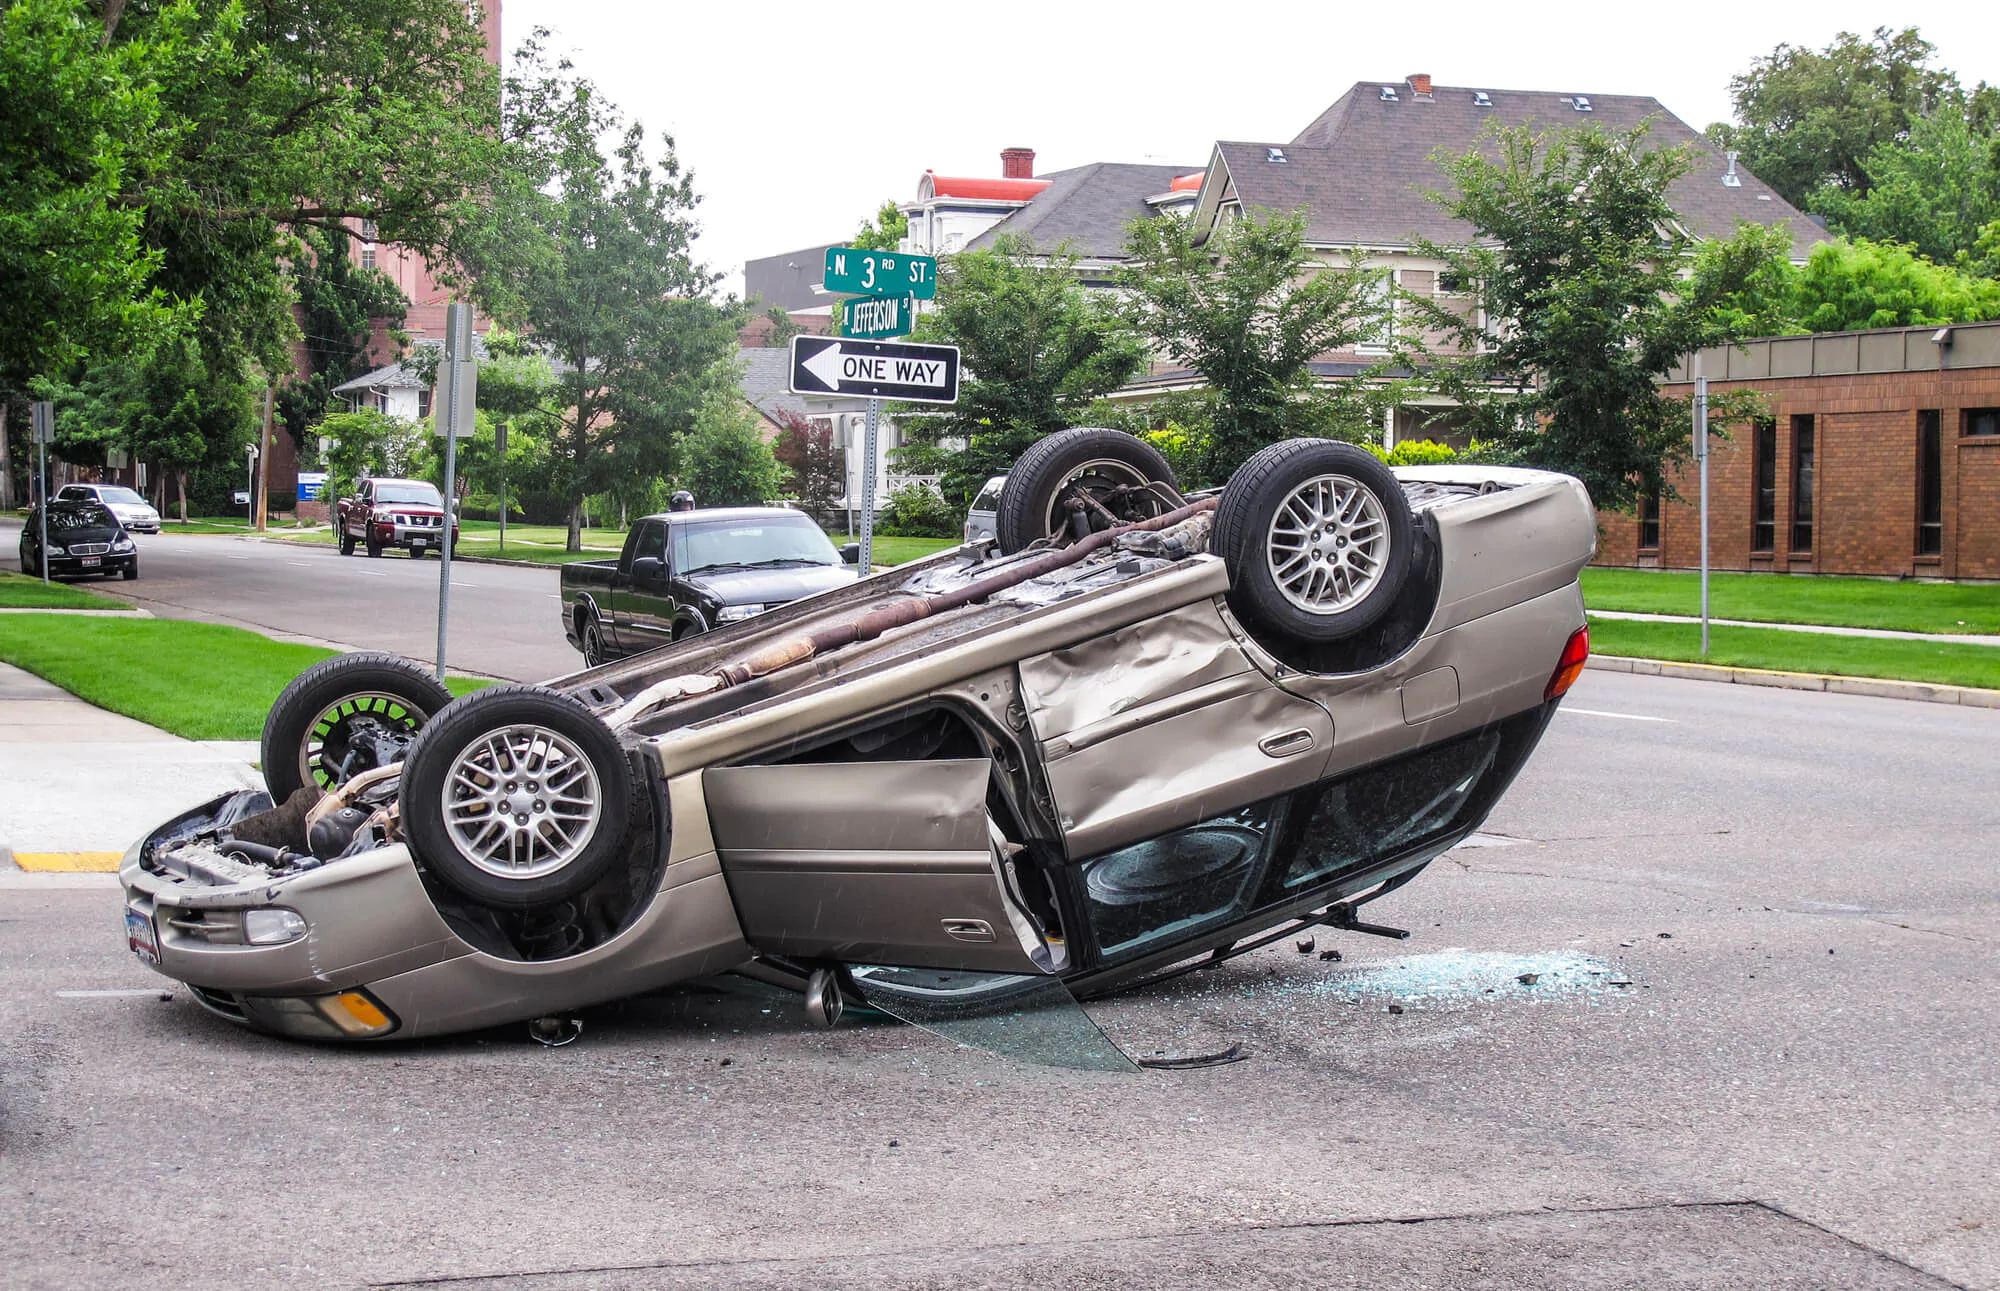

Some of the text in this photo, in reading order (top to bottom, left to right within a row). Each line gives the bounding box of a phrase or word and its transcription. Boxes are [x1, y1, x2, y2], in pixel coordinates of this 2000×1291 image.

[834, 254, 848, 276] N.
[909, 261, 927, 283] ST
[851, 299, 898, 334] JEFFERSON
[843, 357, 940, 384] ONE WAY
